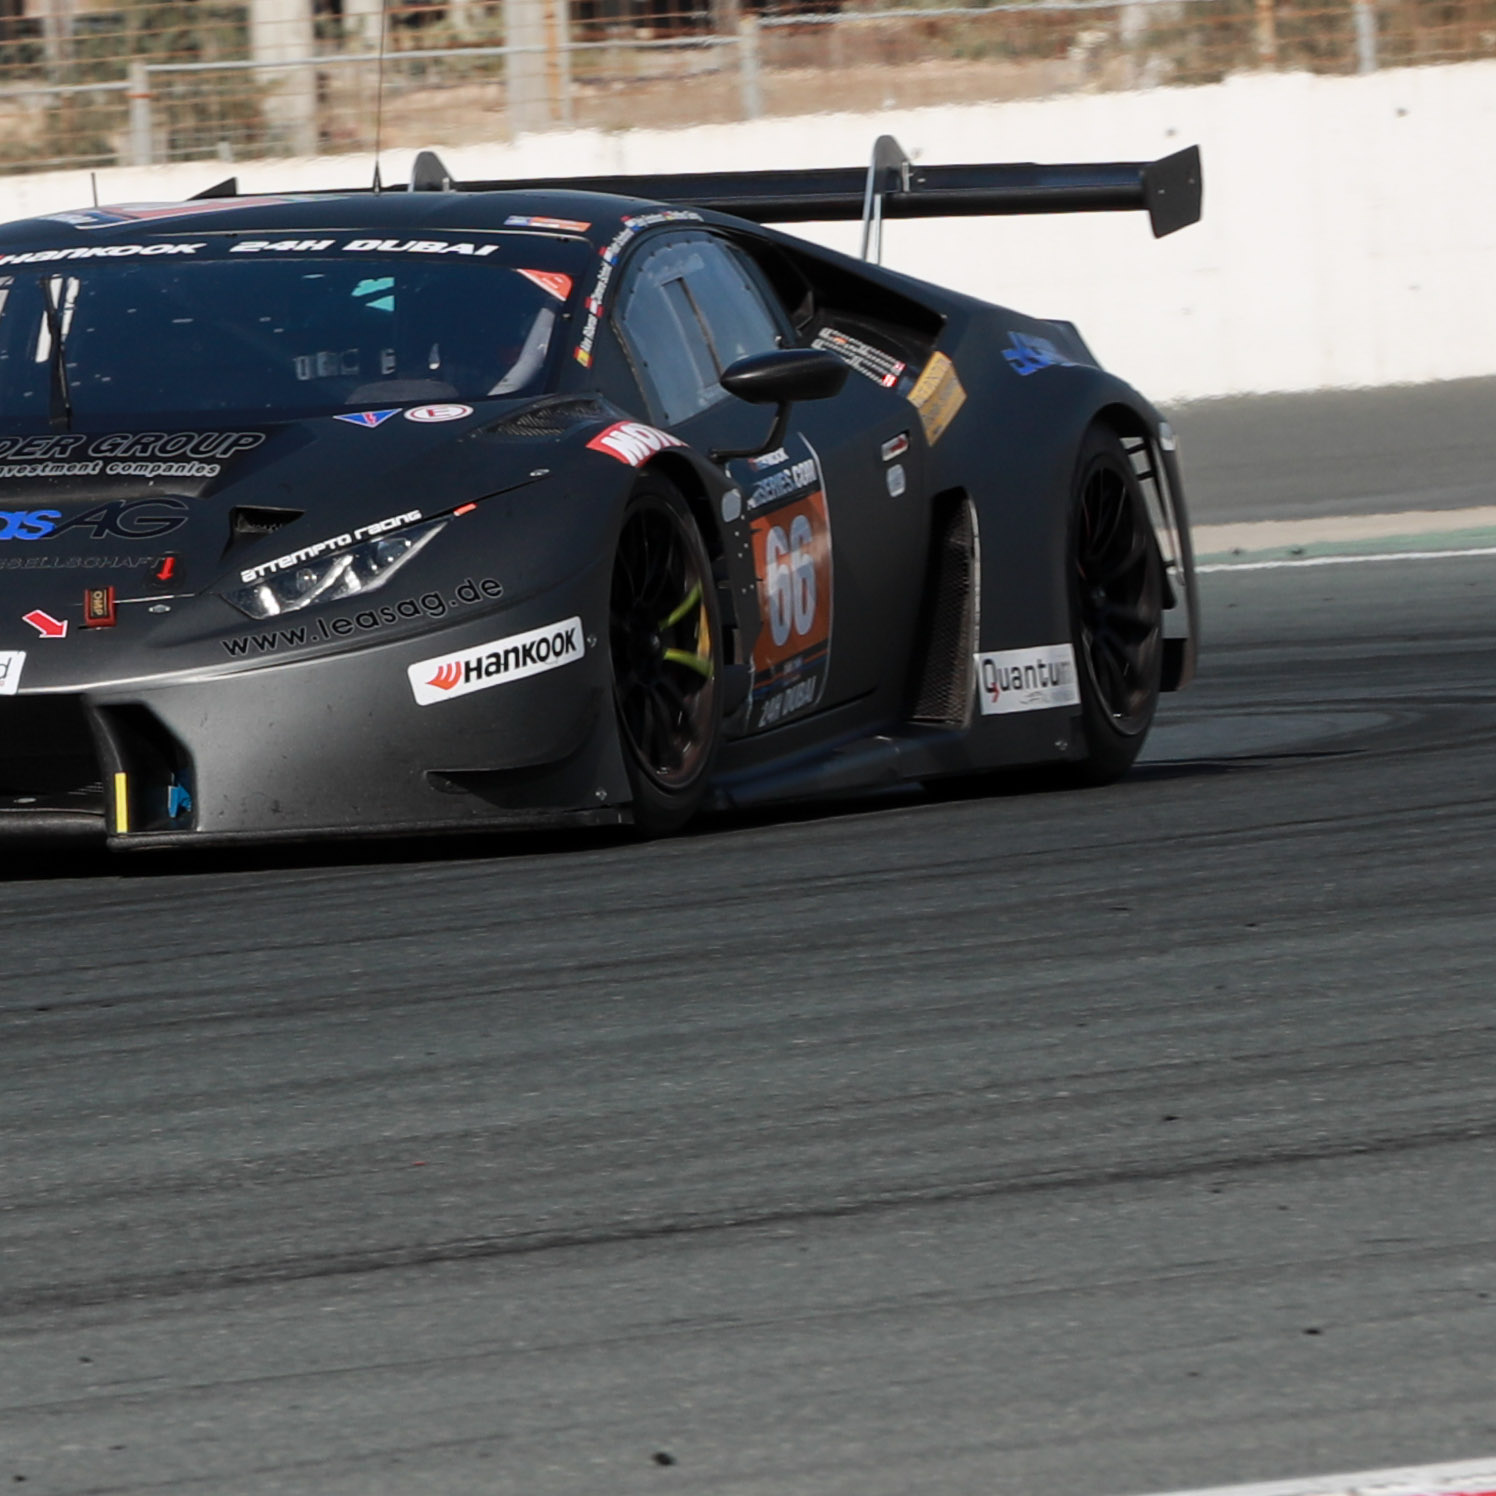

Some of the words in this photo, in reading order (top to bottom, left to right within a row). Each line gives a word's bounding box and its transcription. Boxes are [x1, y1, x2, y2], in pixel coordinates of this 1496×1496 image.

[229, 239, 336, 252] 24H
[342, 239, 500, 256] DUBAI
[88, 432, 266, 458] GROUP
[105, 460, 221, 480] companies
[765, 515, 817, 647] 66
[93, 590, 104, 616] OMP
[220, 577, 504, 657] www.leasag.de
